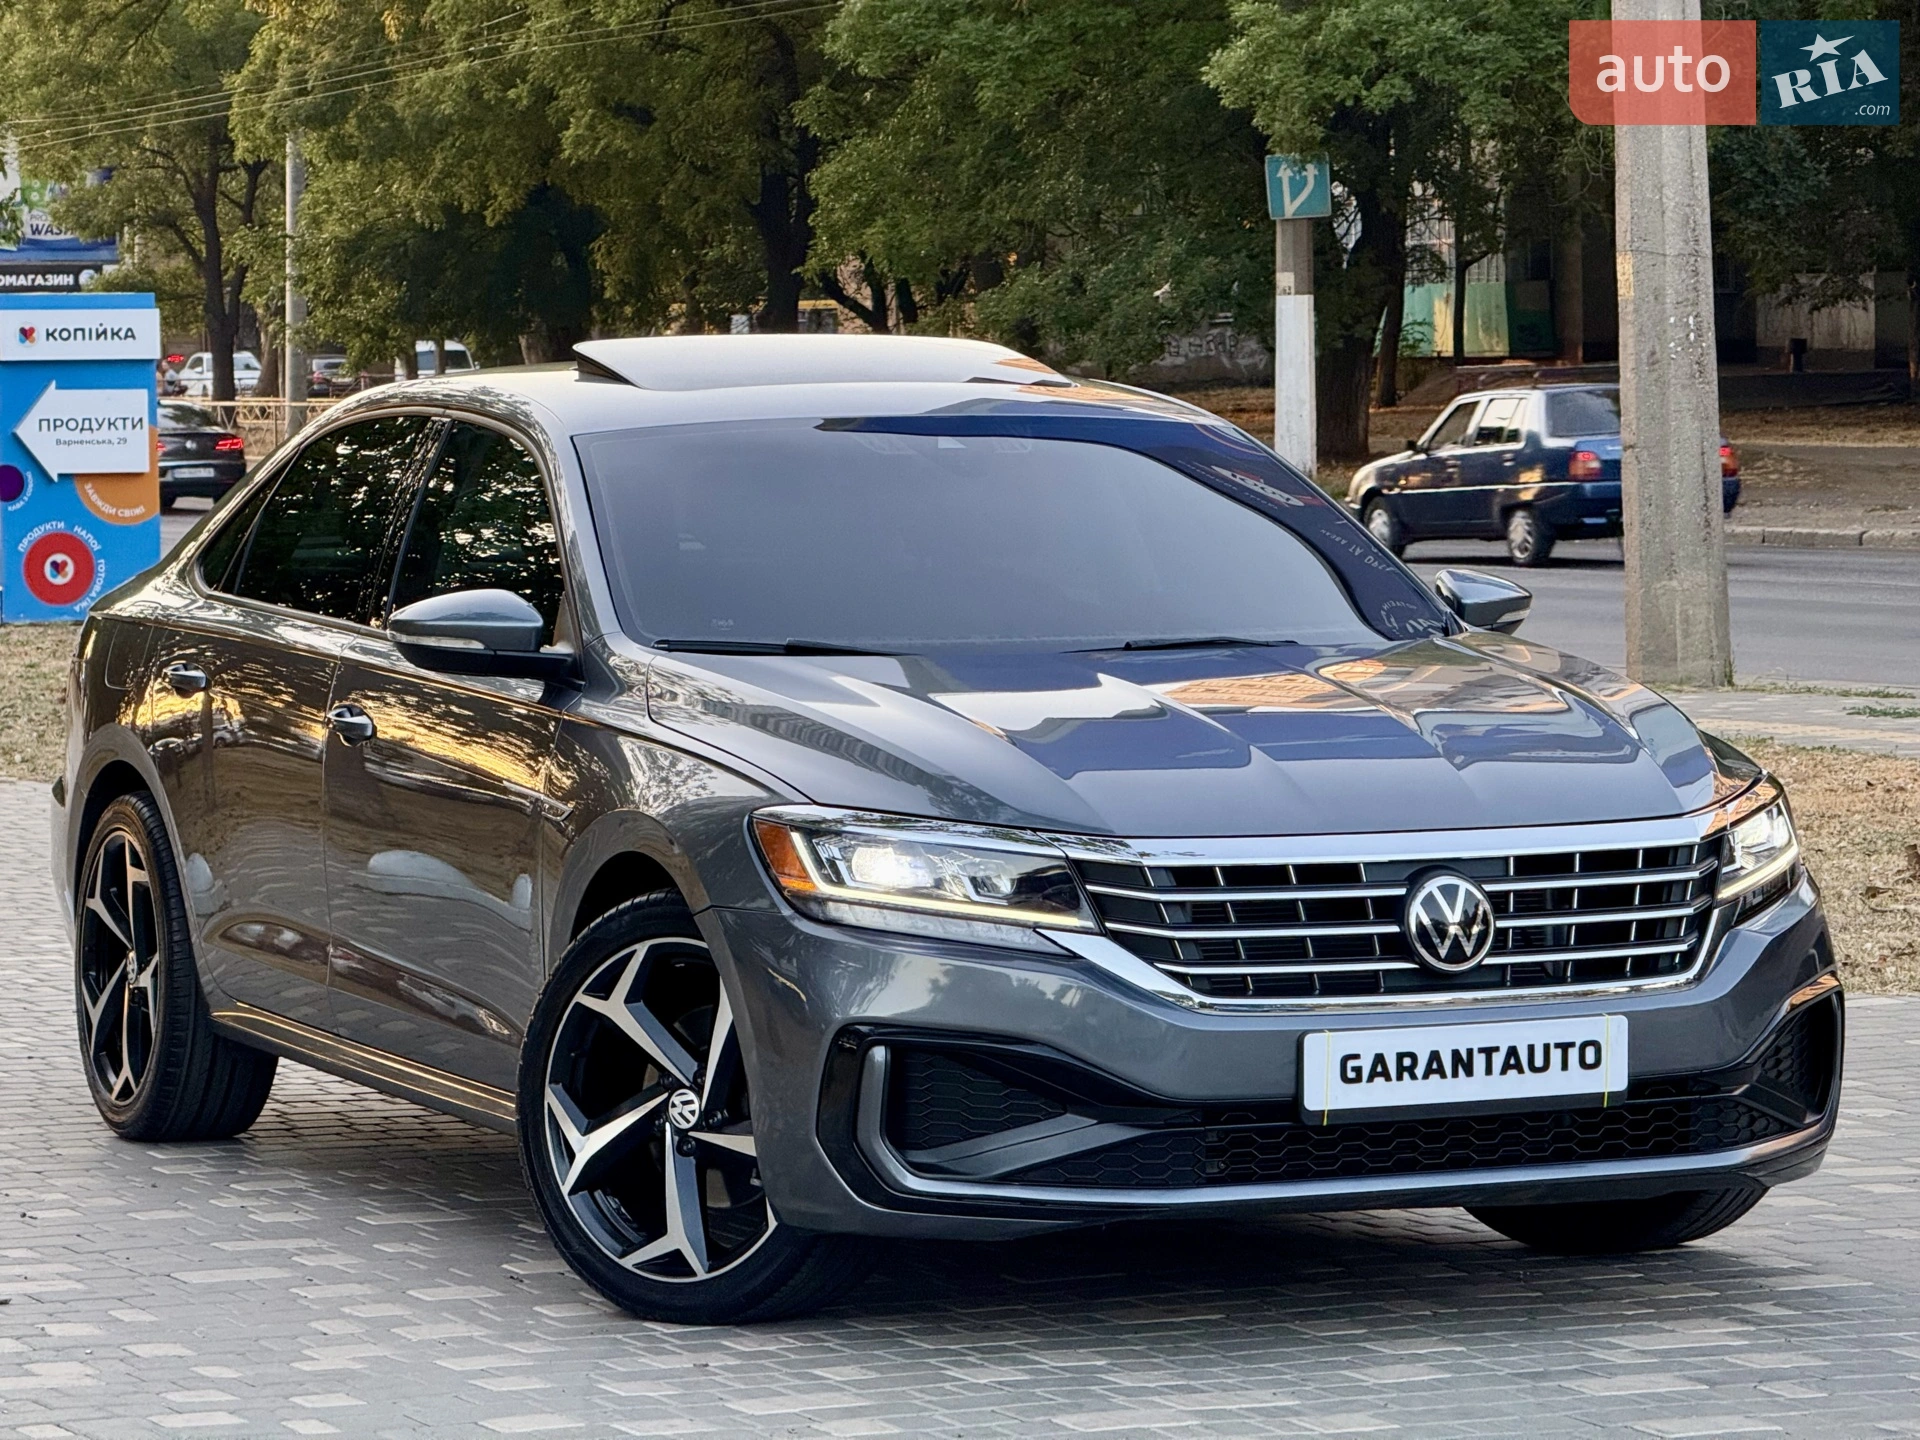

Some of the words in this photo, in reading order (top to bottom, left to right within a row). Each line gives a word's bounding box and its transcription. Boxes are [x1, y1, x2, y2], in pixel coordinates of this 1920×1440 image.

[45, 323, 136, 342] КОПІЙКА
[38, 417, 144, 434] ПРОДУКТИ
[55, 437, 115, 447] Варненська,
[116, 437, 128, 445] 29
[18, 521, 65, 552] ПРОДУКТИ
[1339, 1039, 1603, 1085] GARANTAUTO
